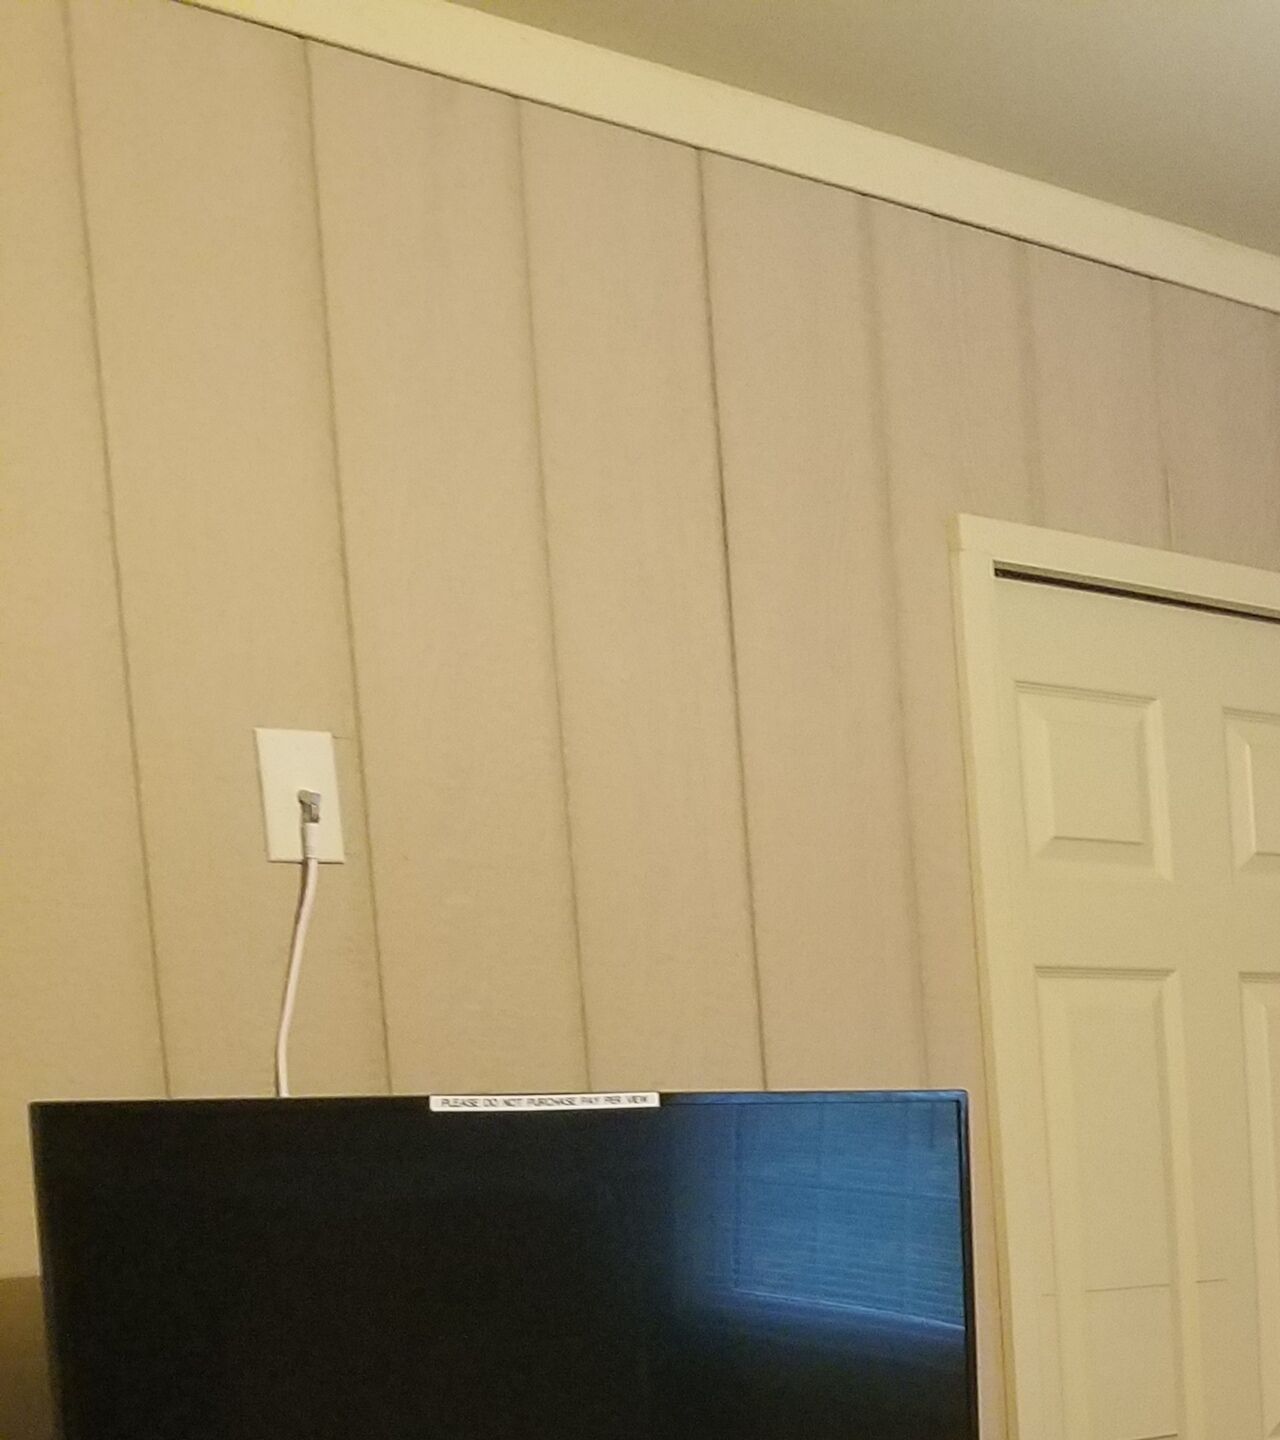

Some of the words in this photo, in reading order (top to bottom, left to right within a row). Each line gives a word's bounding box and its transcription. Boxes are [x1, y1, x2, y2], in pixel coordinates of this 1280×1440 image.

[441, 1098, 478, 1108] PLEASE
[483, 1098, 497, 1107] DO
[503, 1097, 521, 1107] NOT
[527, 1097, 576, 1107] PURCHASE
[605, 1095, 621, 1104] PER
[627, 1094, 647, 1103] VIEW
